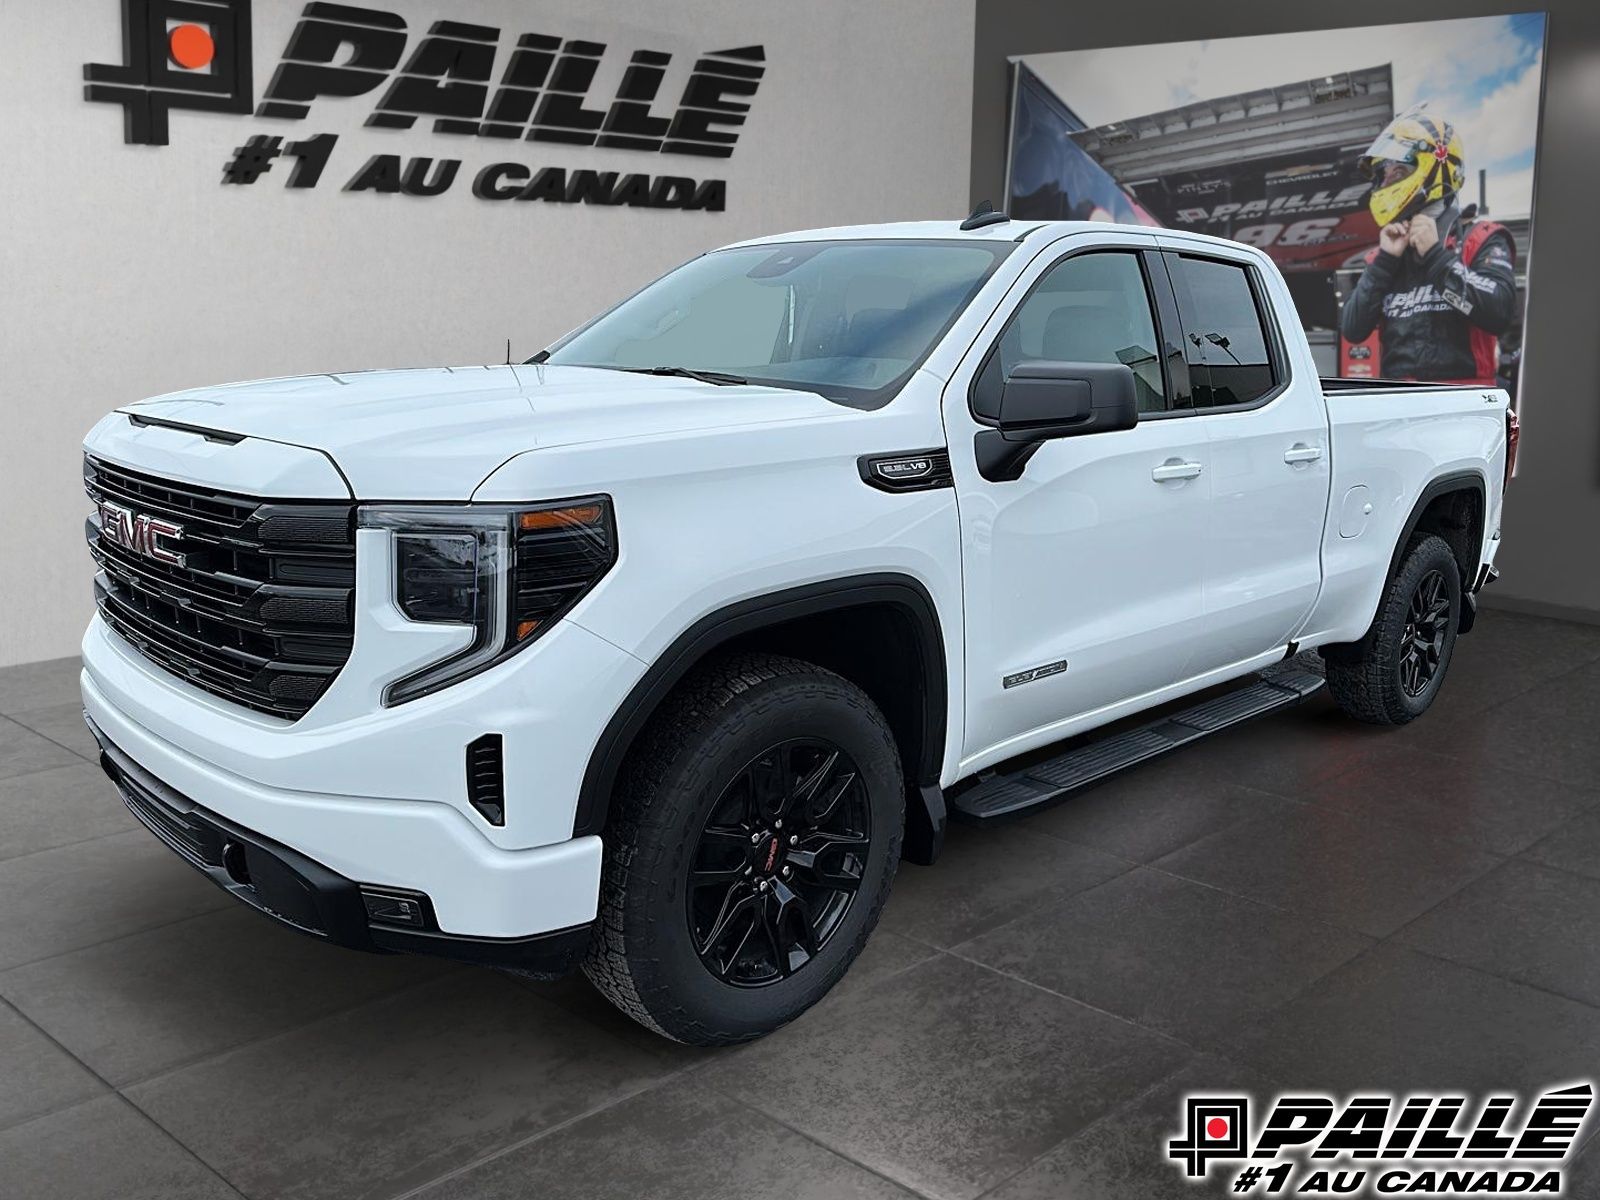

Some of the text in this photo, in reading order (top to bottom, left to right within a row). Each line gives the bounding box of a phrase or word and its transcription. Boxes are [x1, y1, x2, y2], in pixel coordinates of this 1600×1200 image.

[254, 1, 766, 158] PAILLÉ
[220, 134, 727, 212] #1 AU CANADA
[1233, 217, 1341, 248] 96
[101, 501, 187, 569] GMC
